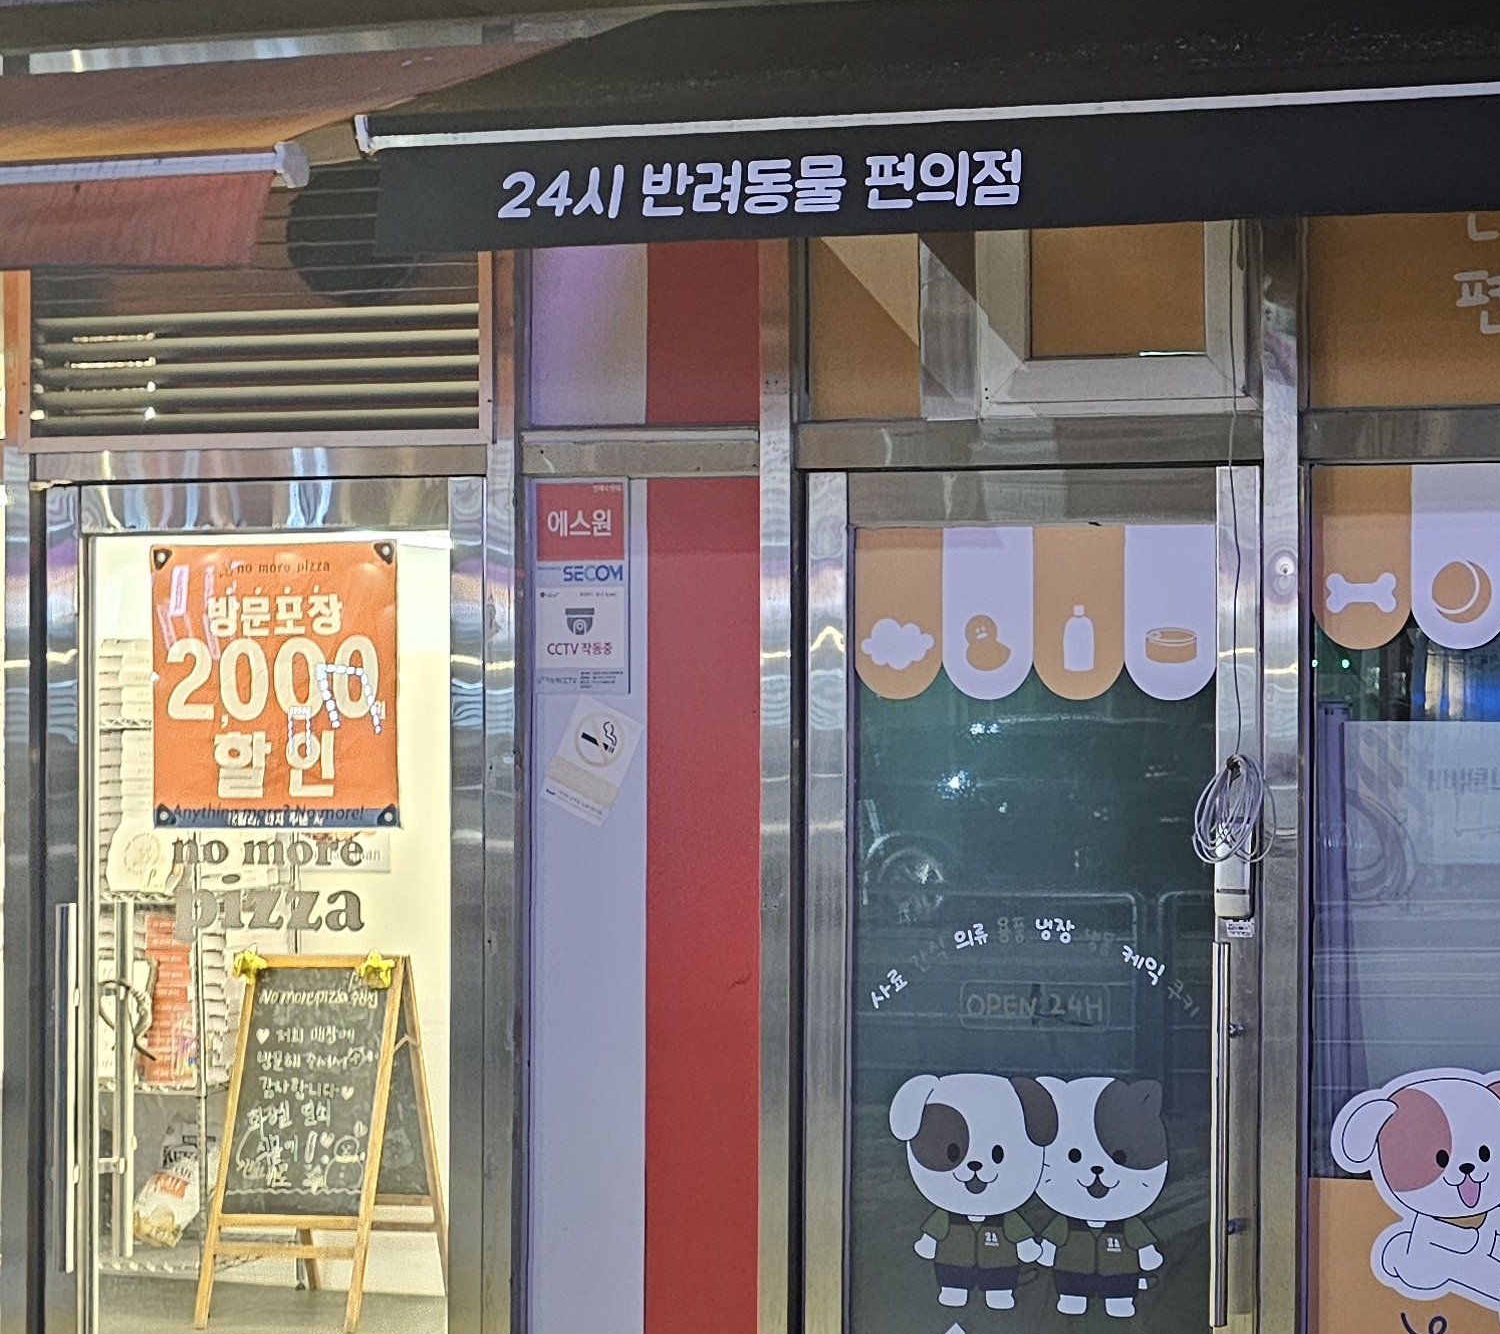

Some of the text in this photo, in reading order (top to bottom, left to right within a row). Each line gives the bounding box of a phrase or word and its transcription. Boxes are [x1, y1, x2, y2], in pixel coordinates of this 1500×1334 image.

[498, 147, 1022, 219] 24시 반려동물 편의점
[547, 508, 612, 537] 에스원
[563, 564, 623, 582] SECOM
[208, 591, 344, 638] 방문포장
[547, 642, 613, 657] CCTV 작동중
[173, 804, 241, 824] Anything
[172, 838, 363, 866] no more
[173, 887, 365, 944] pizza
[870, 968, 908, 1009] 사료
[954, 923, 989, 950] 의류
[1035, 917, 1075, 944] 냉장
[1121, 945, 1165, 986] 케익
[966, 993, 1103, 1022] OPEN 24H
